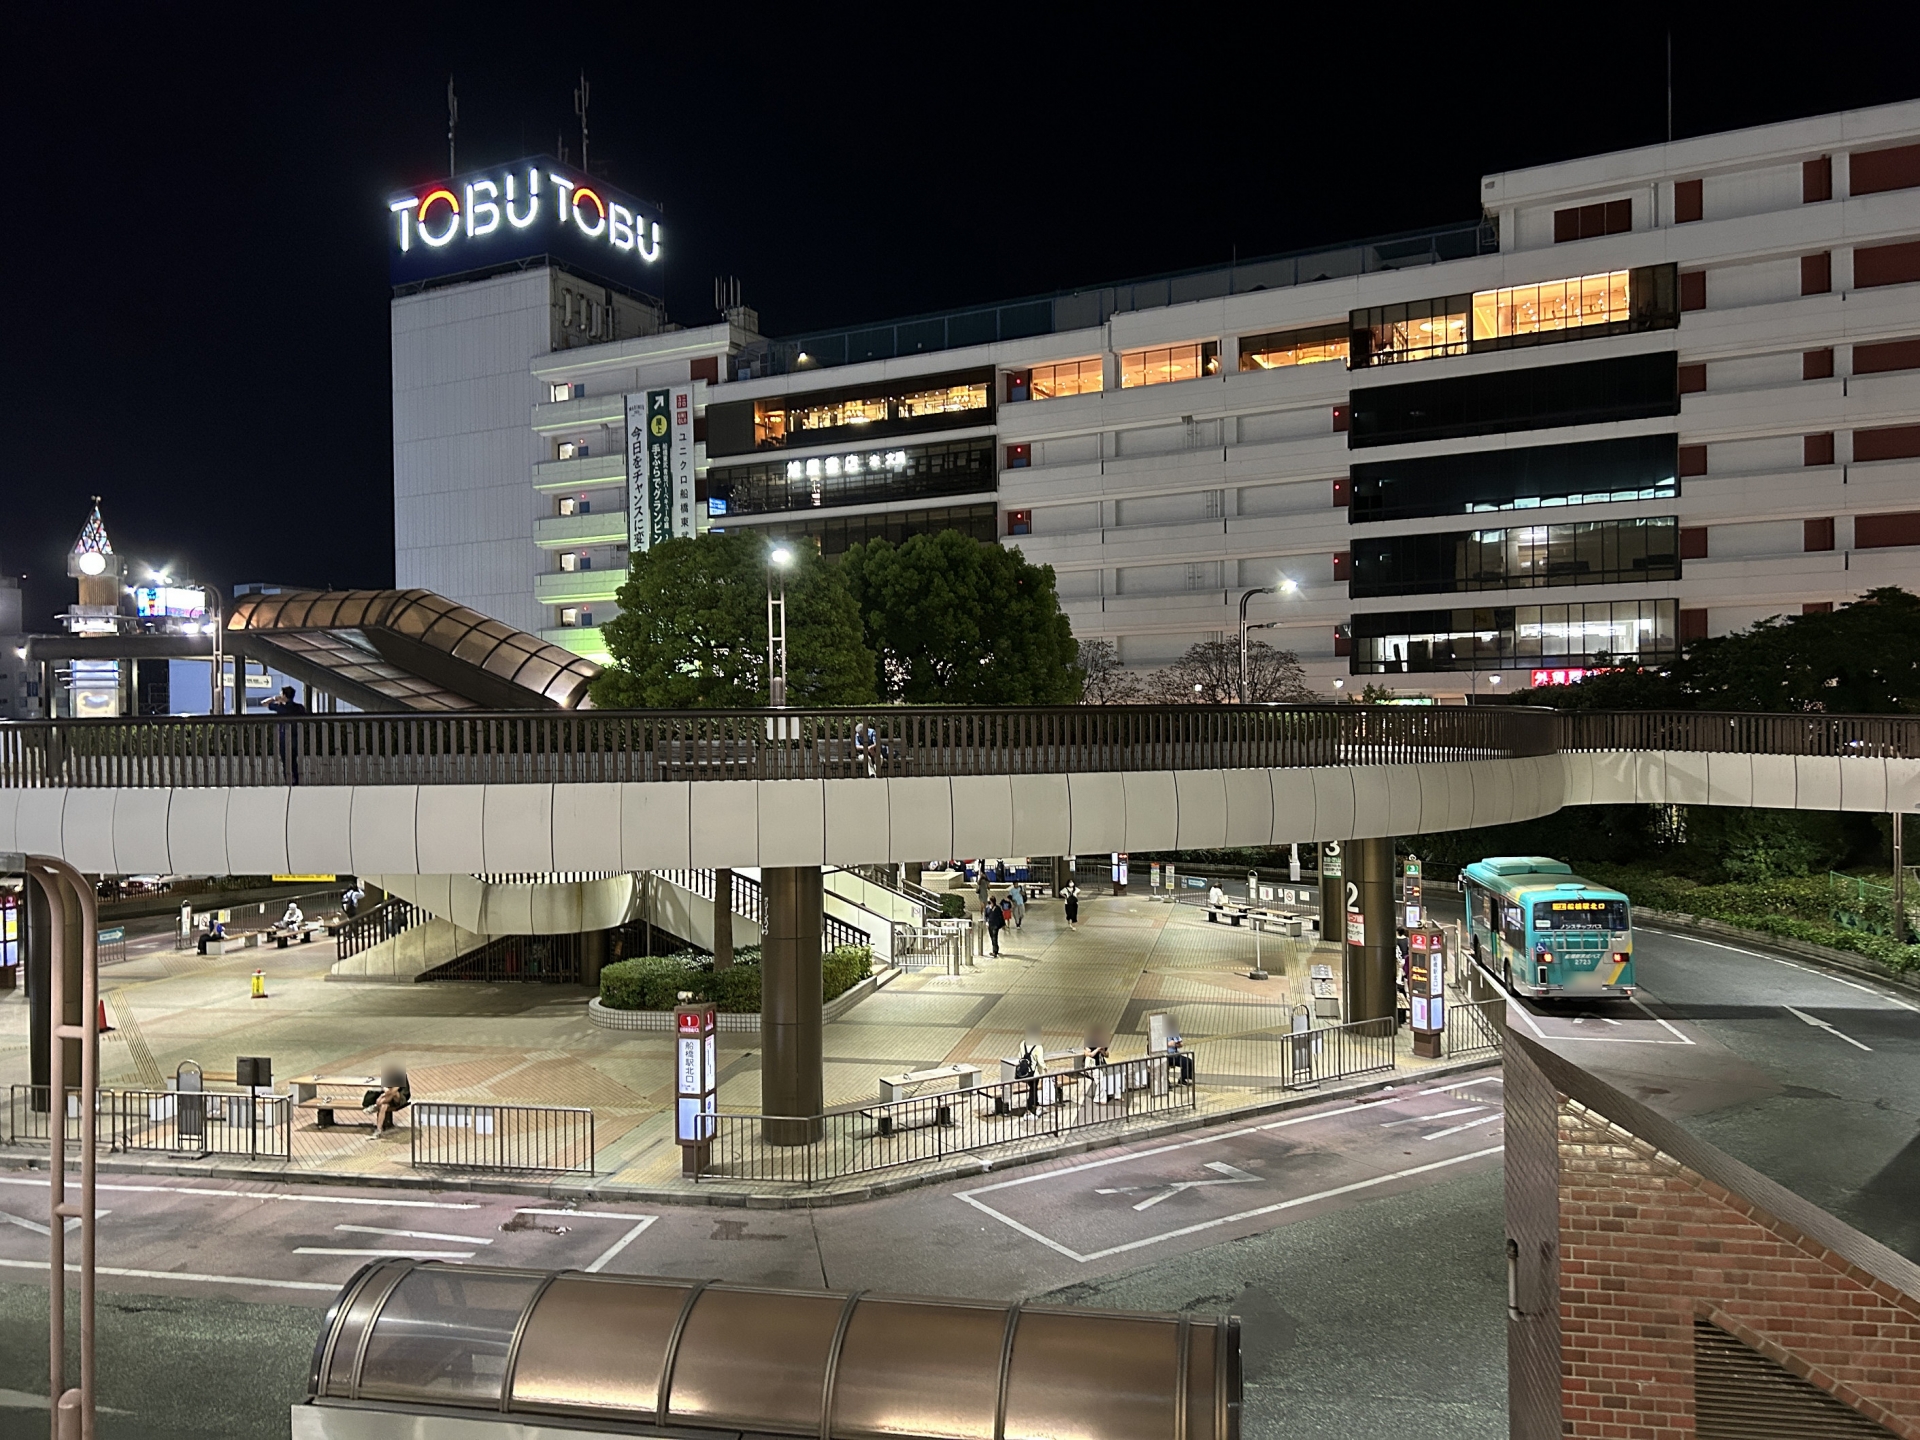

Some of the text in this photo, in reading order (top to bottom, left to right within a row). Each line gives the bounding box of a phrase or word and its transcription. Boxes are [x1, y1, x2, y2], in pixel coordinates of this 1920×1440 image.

[390, 168, 539, 253] TOBU
[549, 173, 660, 262] TOBU
[631, 426, 645, 551] 今日をチャンスに変
[1325, 840, 1340, 856] 3
[1347, 882, 1359, 912] 2
[686, 1016, 691, 1026] 1
[686, 1041, 694, 1083] 船橋駅北口
